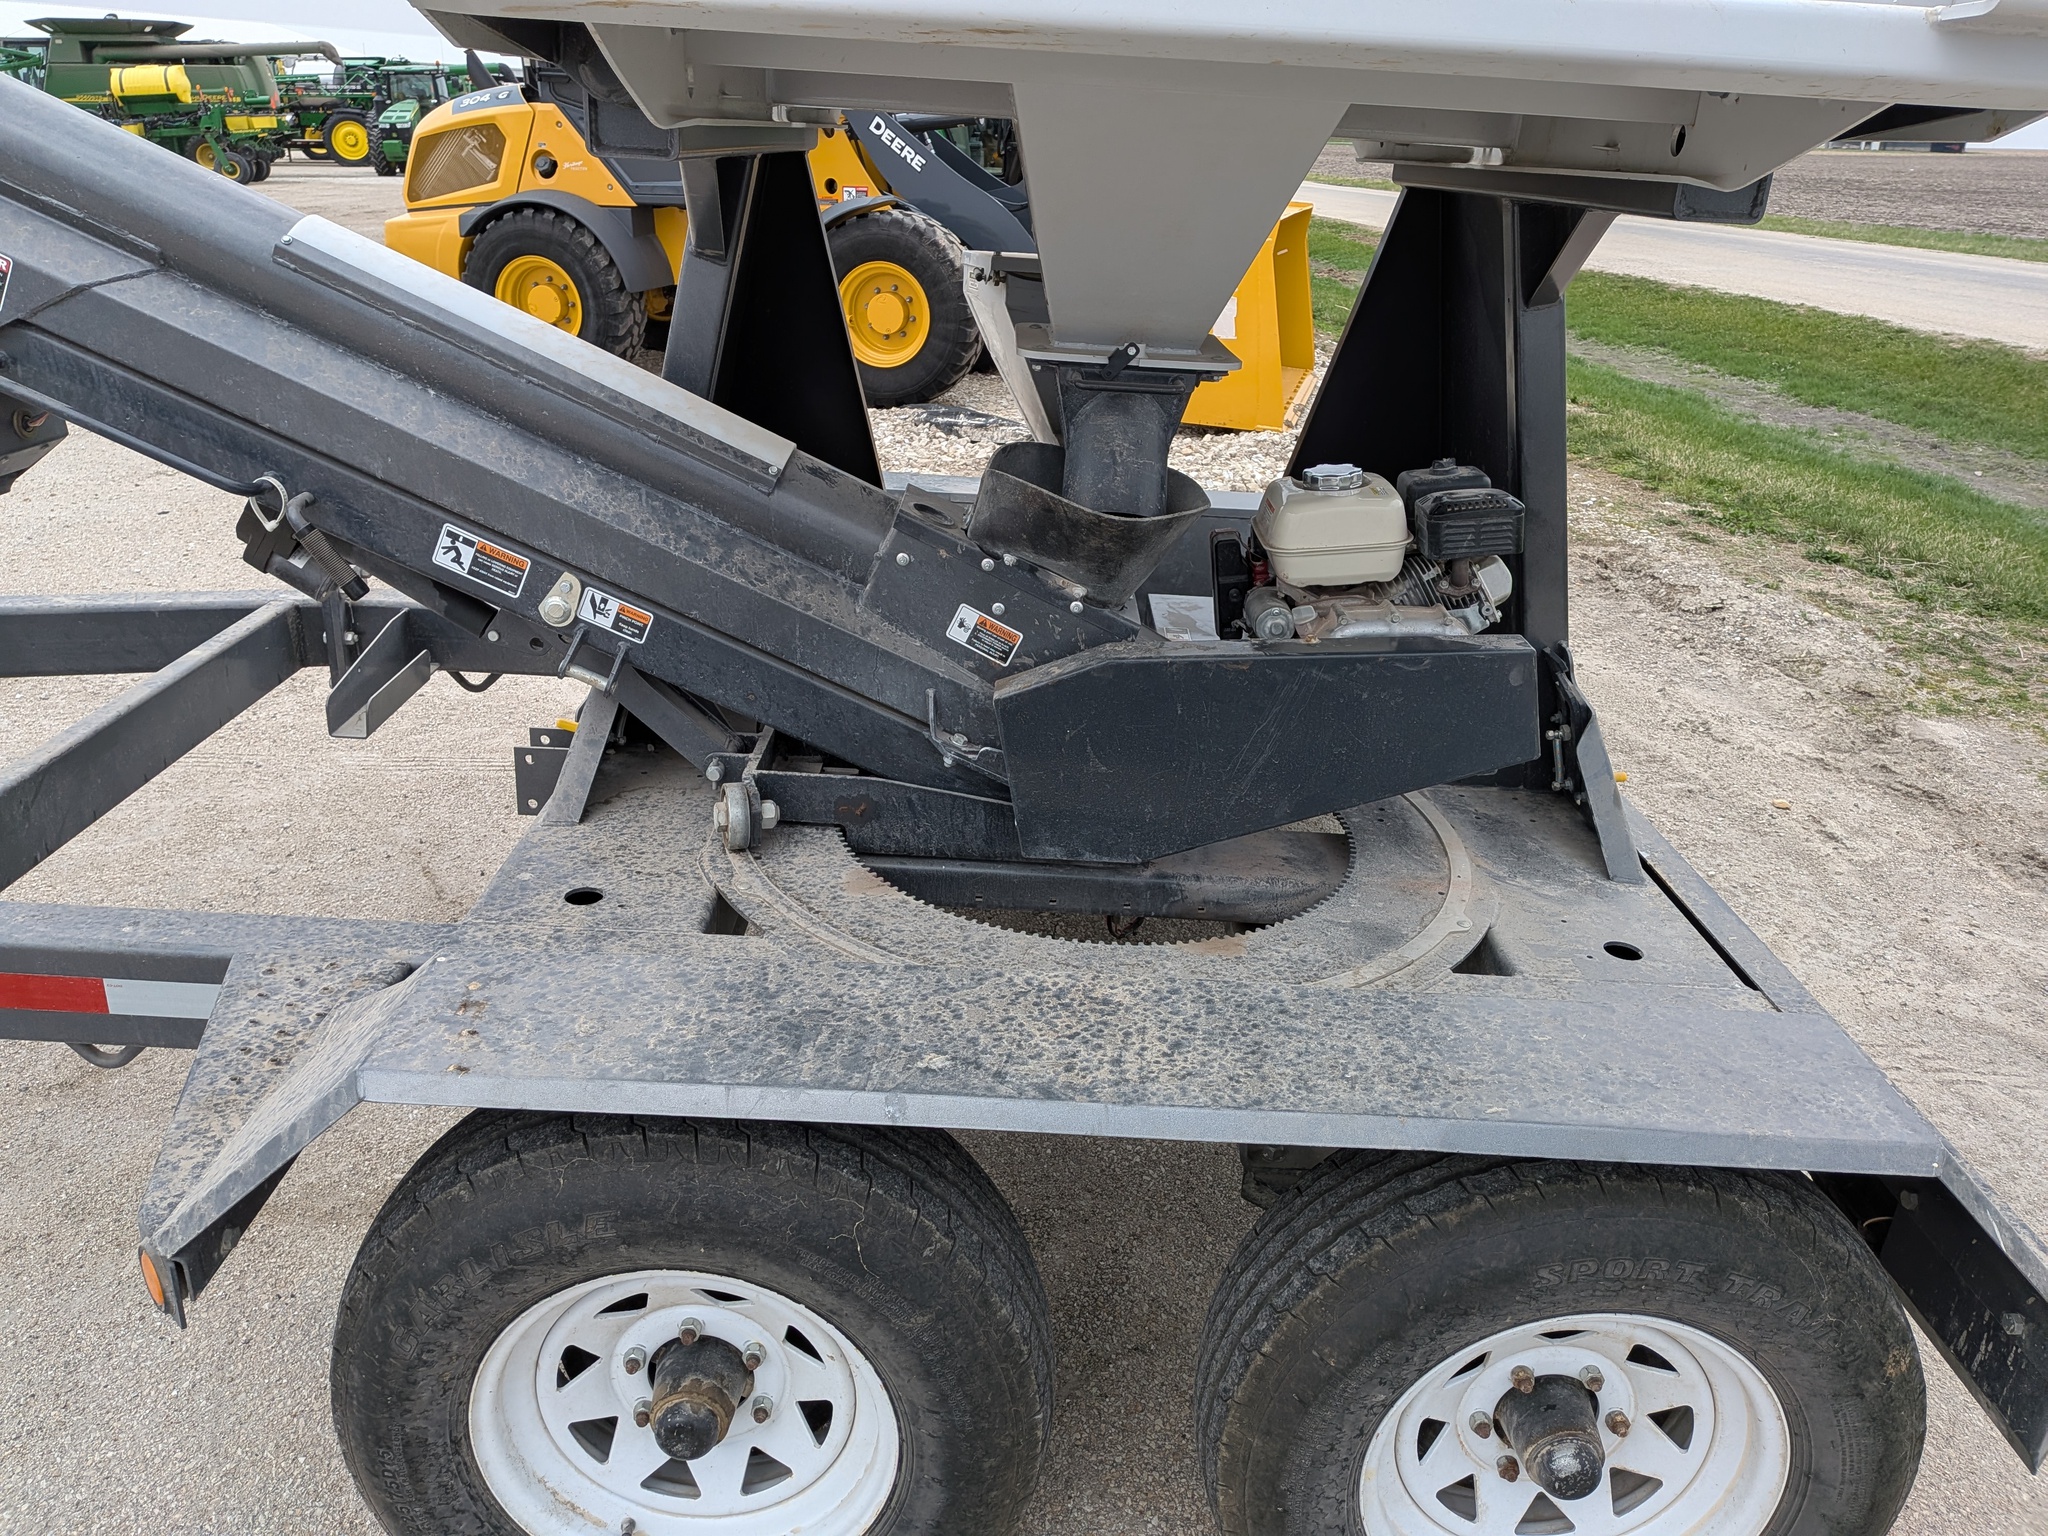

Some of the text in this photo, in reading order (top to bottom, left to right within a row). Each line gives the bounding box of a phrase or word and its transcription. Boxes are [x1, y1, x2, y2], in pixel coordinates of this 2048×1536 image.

[460, 91, 510, 107] 304 G
[868, 115, 927, 172] DEERE
[489, 547, 525, 568] WARNING
[626, 609, 649, 622] WARNING
[989, 622, 1017, 642] WARNING
[1534, 1256, 1711, 1289] SPORT
[389, 1210, 622, 1361] CARLISLE
